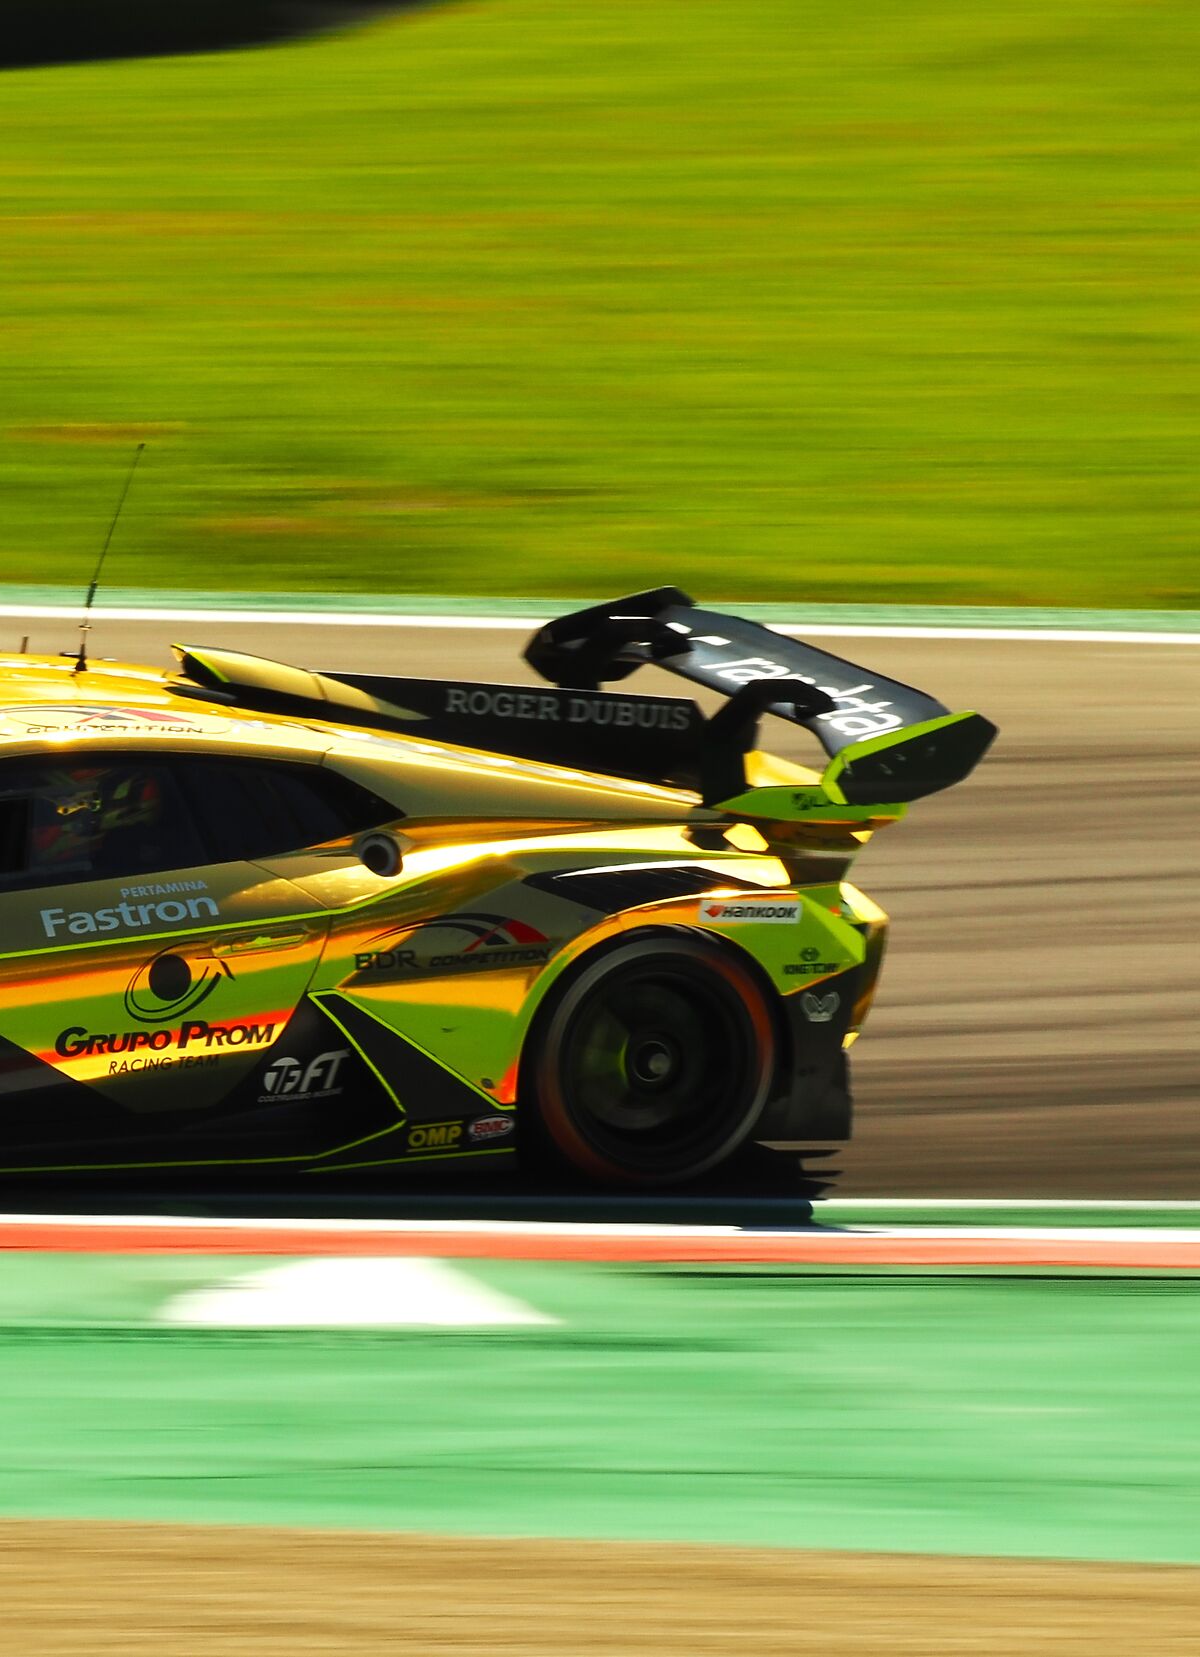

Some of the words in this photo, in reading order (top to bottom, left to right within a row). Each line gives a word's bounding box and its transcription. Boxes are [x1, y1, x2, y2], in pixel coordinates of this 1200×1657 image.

[445, 688, 560, 721] ROGER
[568, 698, 691, 731] DUBUIS
[120, 880, 208, 899] PERTAMINA
[40, 896, 220, 938] Fastron
[354, 950, 422, 970] BDR
[429, 948, 552, 968] COMPETITION
[55, 1026, 172, 1058] GRUPO
[177, 1020, 276, 1049] PROM
[108, 1057, 173, 1075] RACING
[178, 1054, 220, 1070] TEAM
[407, 1125, 462, 1147] OMP
